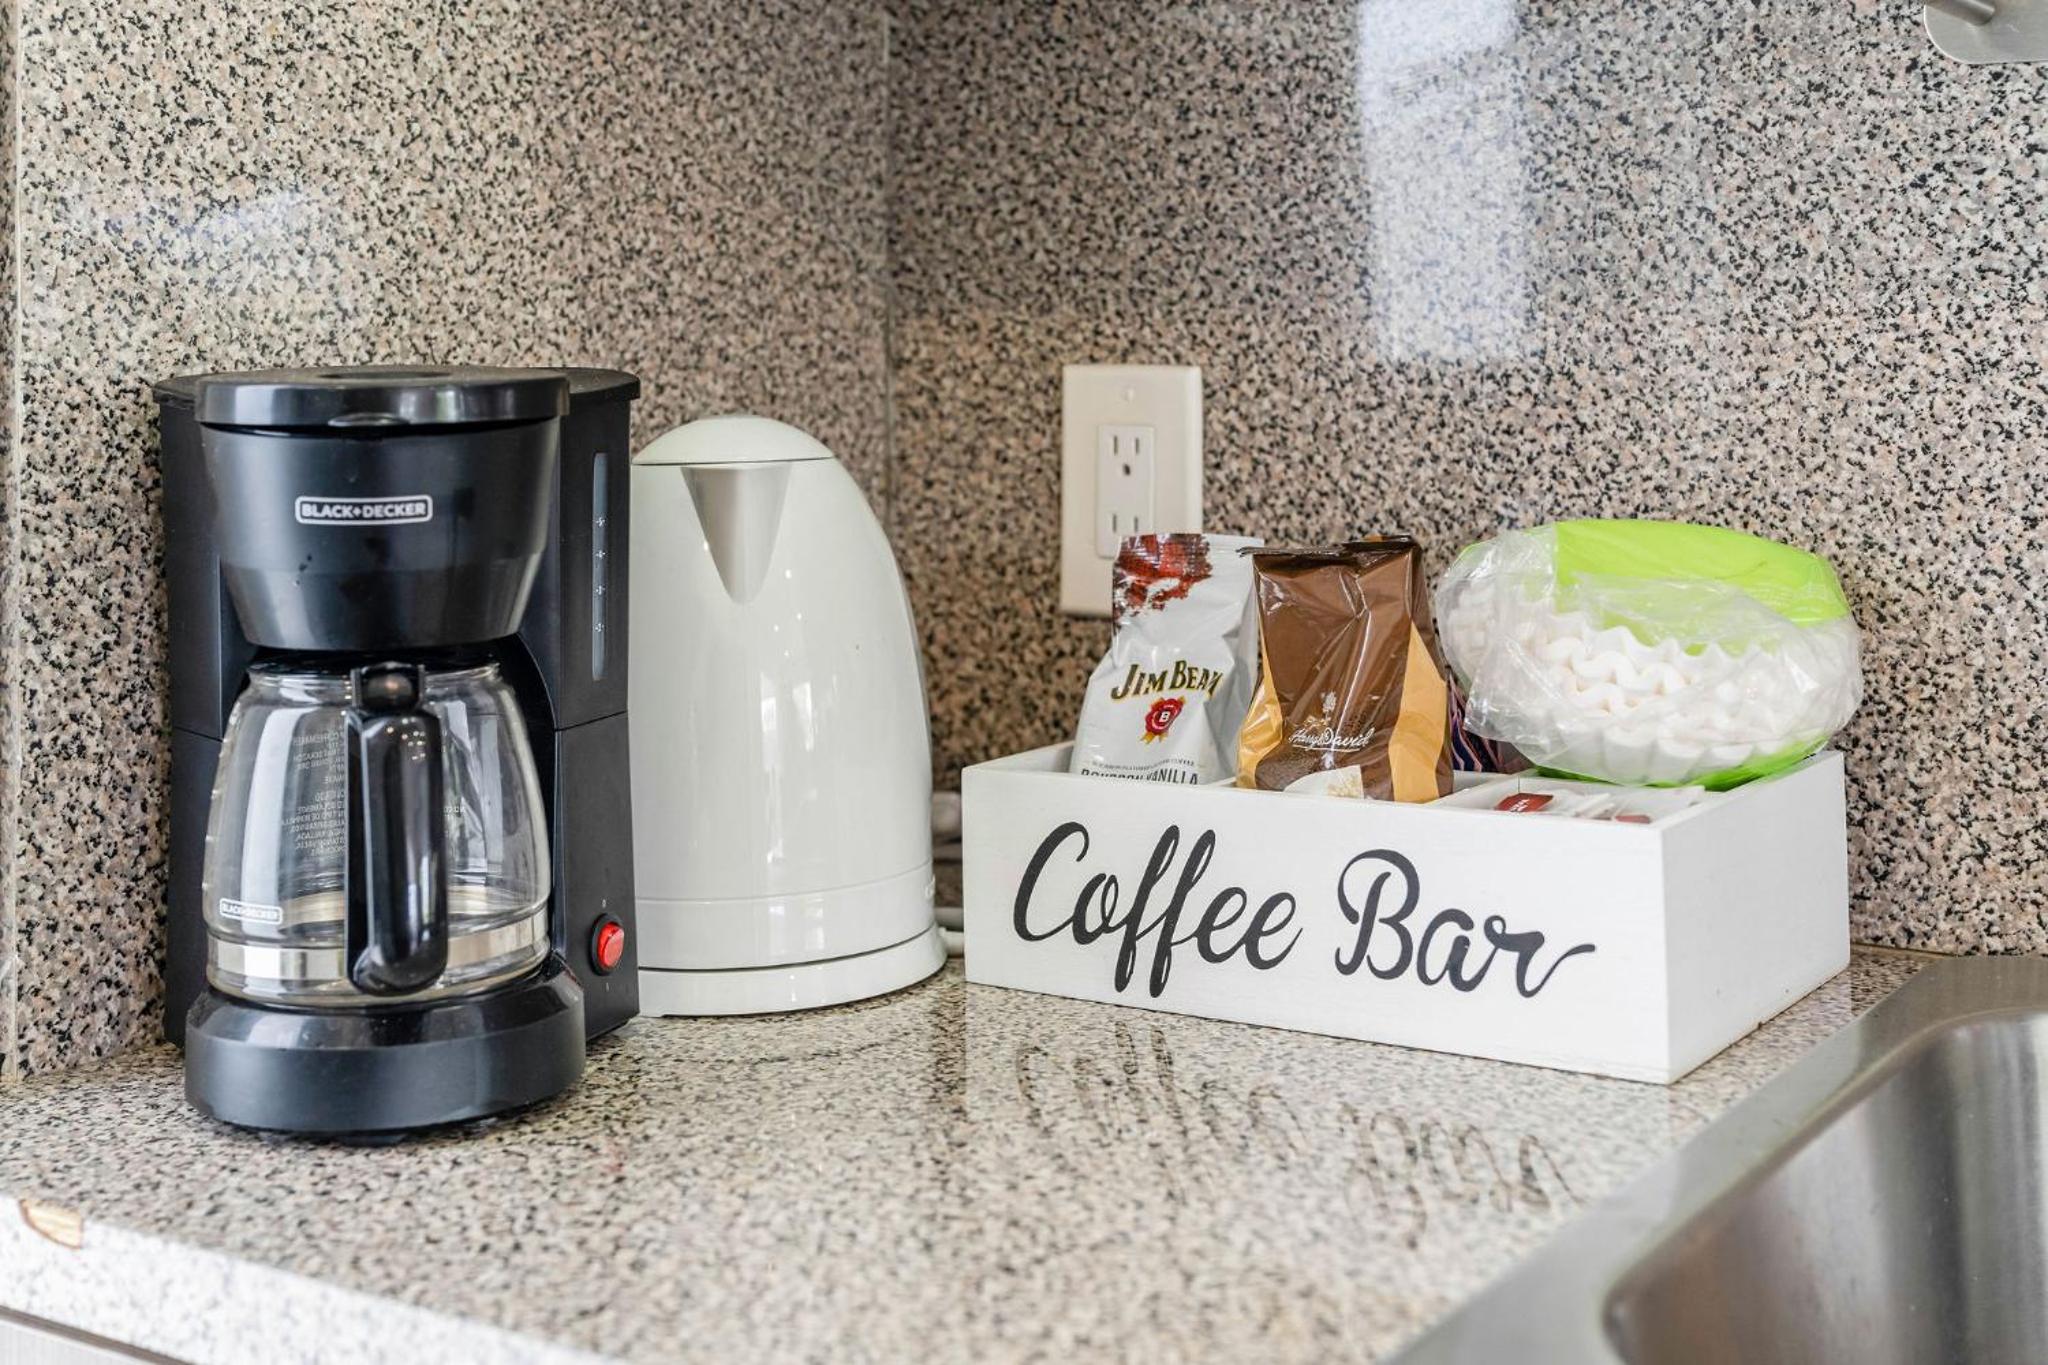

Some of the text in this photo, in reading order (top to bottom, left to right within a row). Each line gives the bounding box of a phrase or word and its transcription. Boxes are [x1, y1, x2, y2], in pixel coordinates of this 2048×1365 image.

[301, 502, 426, 518] BLACK+DECKER
[1110, 663, 1168, 700] JIM
[1013, 820, 1597, 999] Coffee Bar
